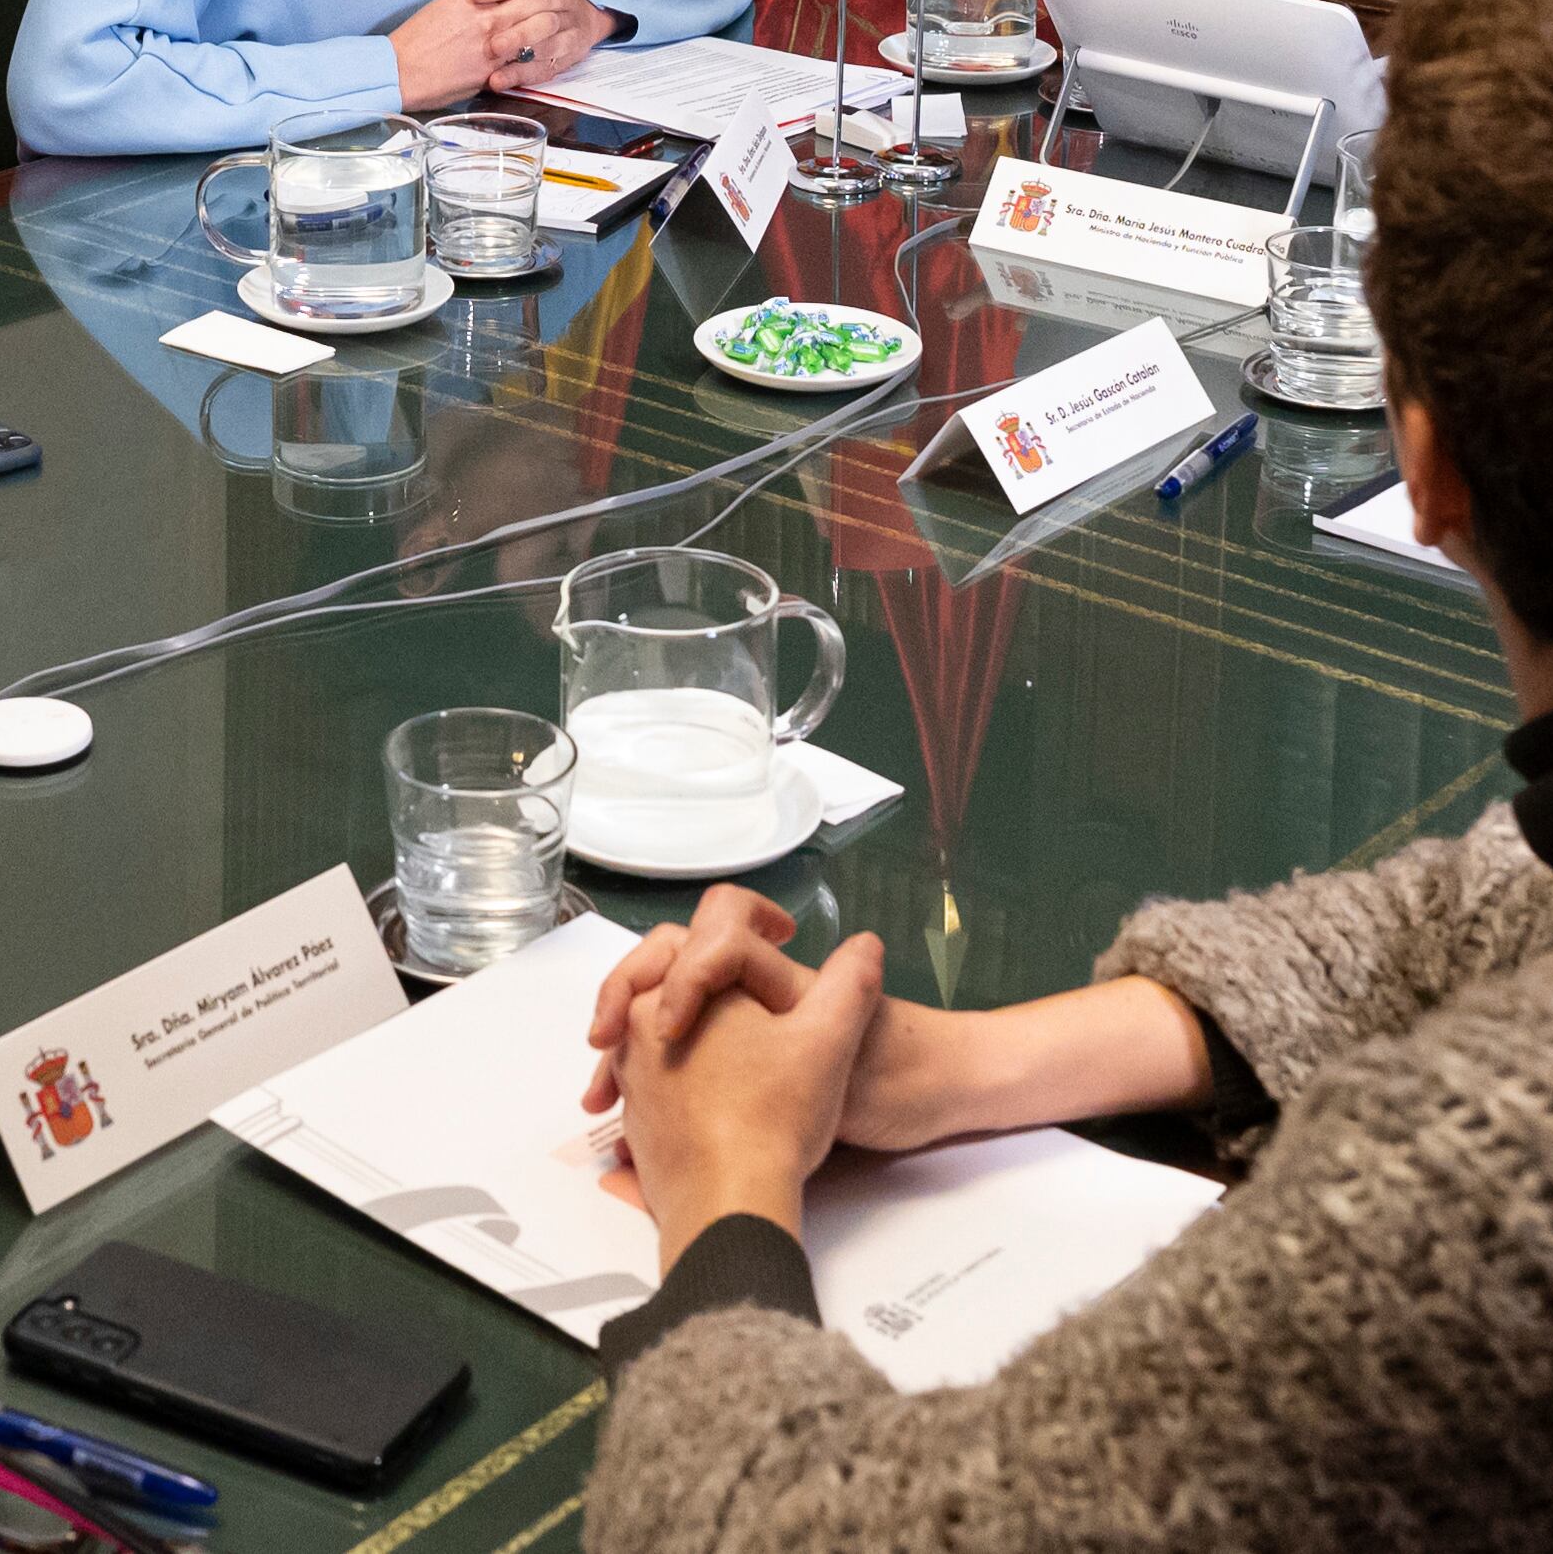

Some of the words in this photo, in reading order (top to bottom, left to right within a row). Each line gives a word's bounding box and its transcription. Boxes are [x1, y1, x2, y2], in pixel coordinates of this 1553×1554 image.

[1065, 204, 1085, 218] Sra.
[1089, 209, 1112, 224] Dña.
[1115, 215, 1146, 231] María
[1148, 222, 1176, 237] Jesús
[1179, 228, 1223, 247] Montero
[1123, 232, 1133, 241] de
[1135, 235, 1173, 249] Hacienda
[1174, 243, 1180, 251] y
[1045, 412, 1060, 425] Sr.
[1058, 406, 1070, 419] D.
[1069, 393, 1095, 415] Jesús
[1093, 379, 1127, 402] Gascón
[1126, 363, 1161, 386] Catalán
[1094, 411, 1103, 420] de
[1102, 402, 1123, 417] Estado
[1122, 398, 1130, 406] de
[131, 1032, 161, 1052] Sra.
[161, 1011, 196, 1036] Dña.
[196, 981, 250, 1016] Miryam
[250, 953, 301, 989] Álvarez
[198, 1015, 240, 1041] General
[241, 1006, 253, 1018] de
